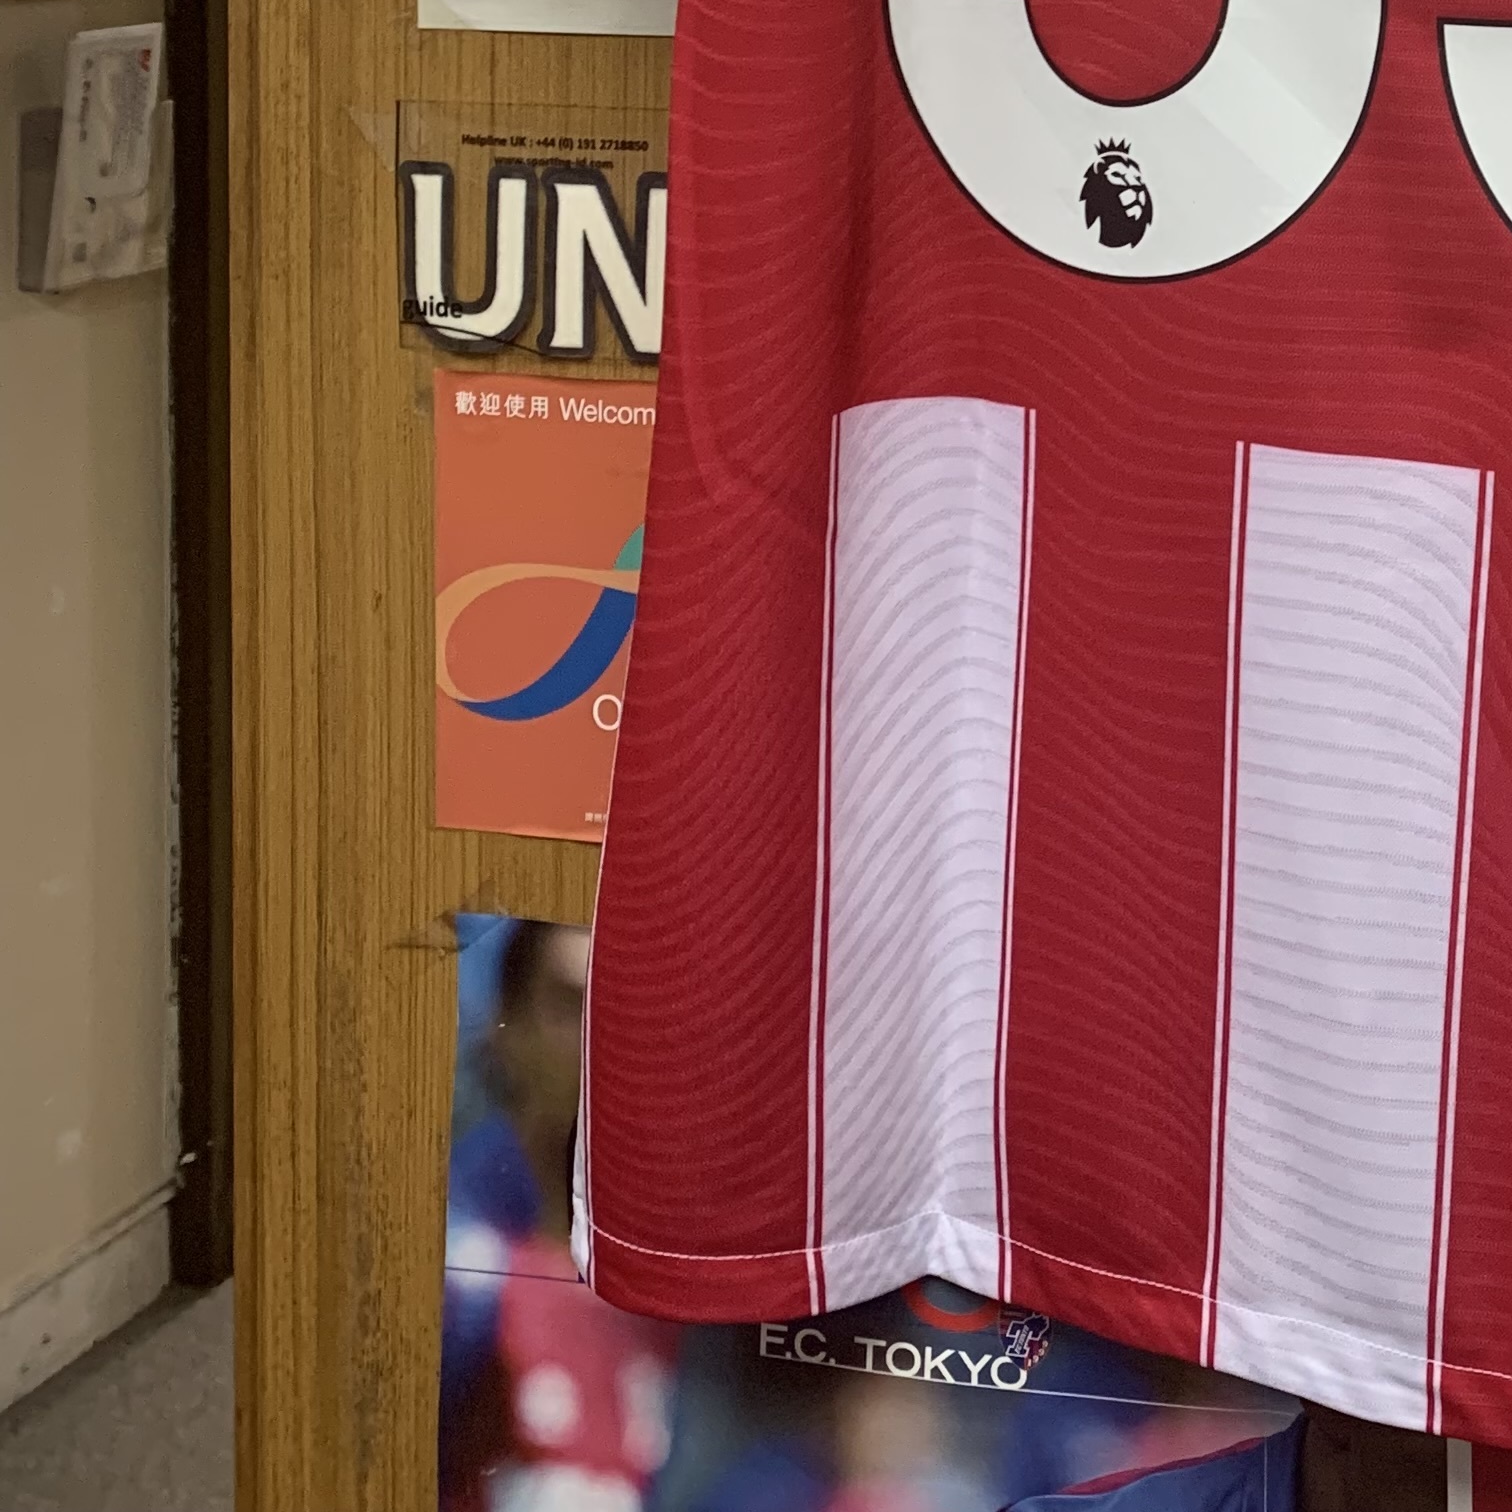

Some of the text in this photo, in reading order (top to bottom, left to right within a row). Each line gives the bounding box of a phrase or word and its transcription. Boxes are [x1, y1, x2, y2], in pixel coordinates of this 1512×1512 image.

[461, 133, 507, 147] Helpline
[510, 136, 527, 147] UK
[536, 137, 556, 148] +44
[402, 296, 464, 320] guide
[455, 391, 549, 420] 歡迎使用
[854, 1336, 1028, 1390] TOKYO
